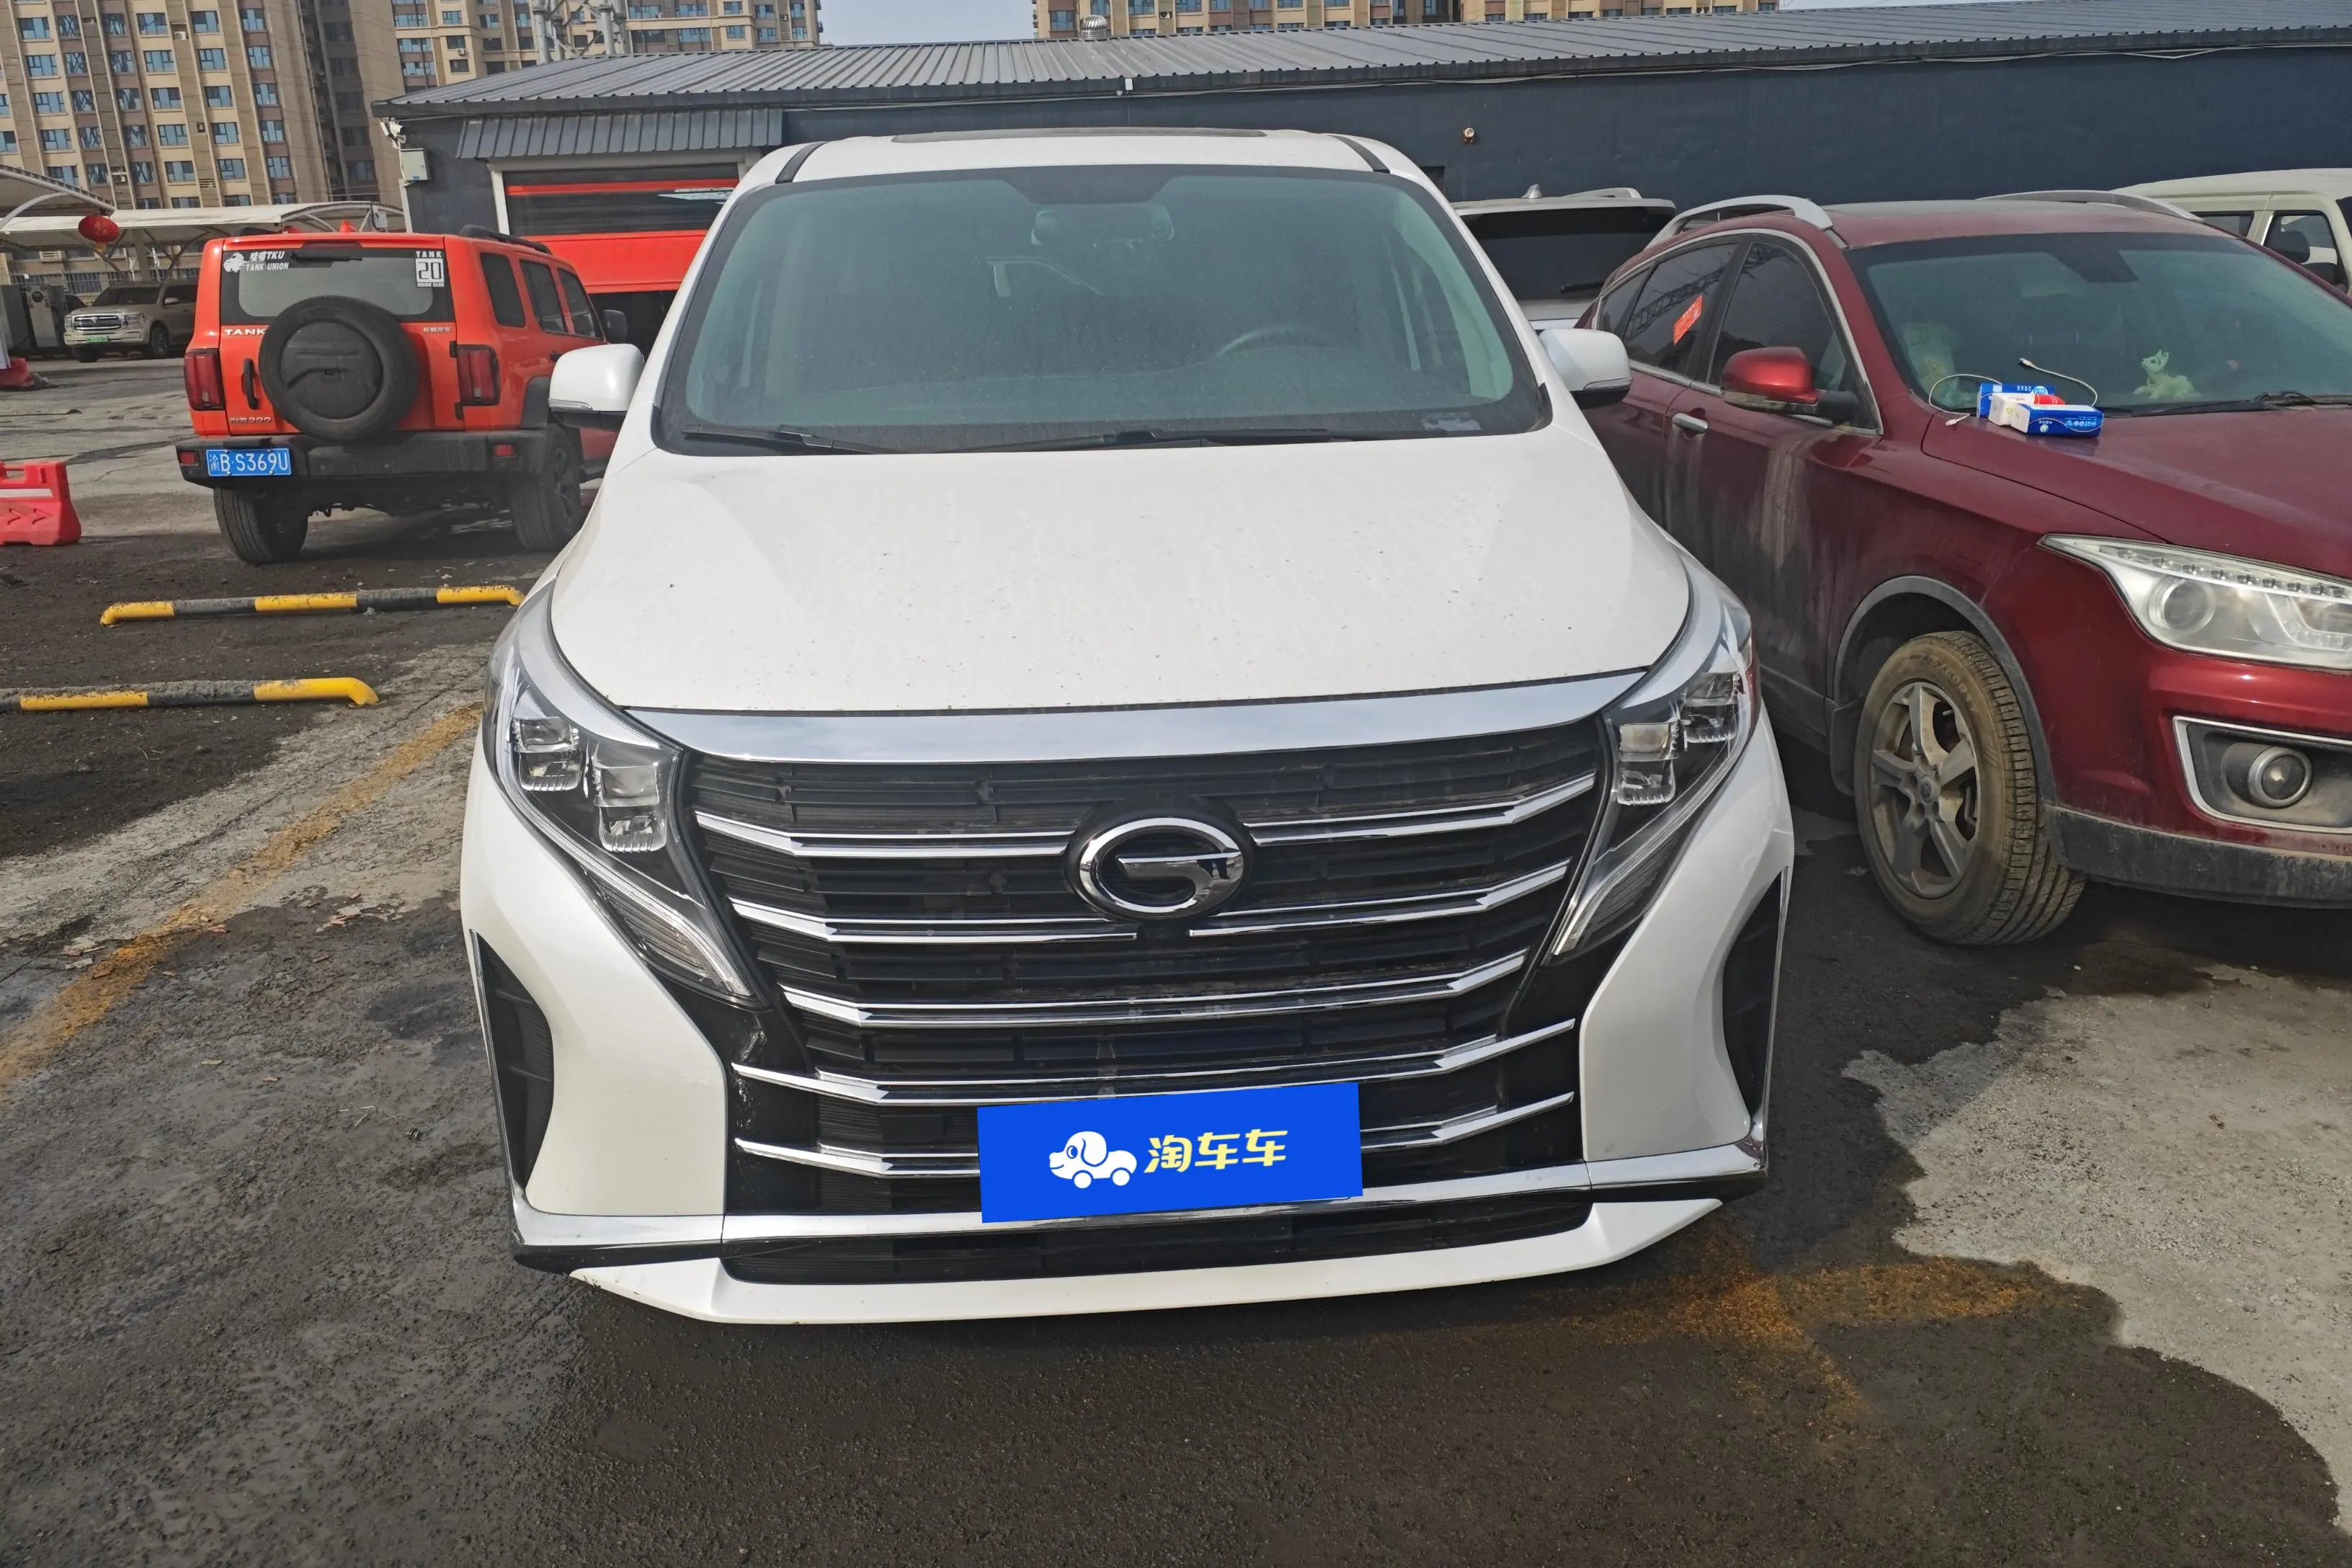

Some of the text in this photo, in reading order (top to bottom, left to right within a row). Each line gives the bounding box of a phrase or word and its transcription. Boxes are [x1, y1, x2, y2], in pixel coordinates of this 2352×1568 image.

[246, 262, 290, 272] TANK UNION
[417, 262, 442, 280] 20
